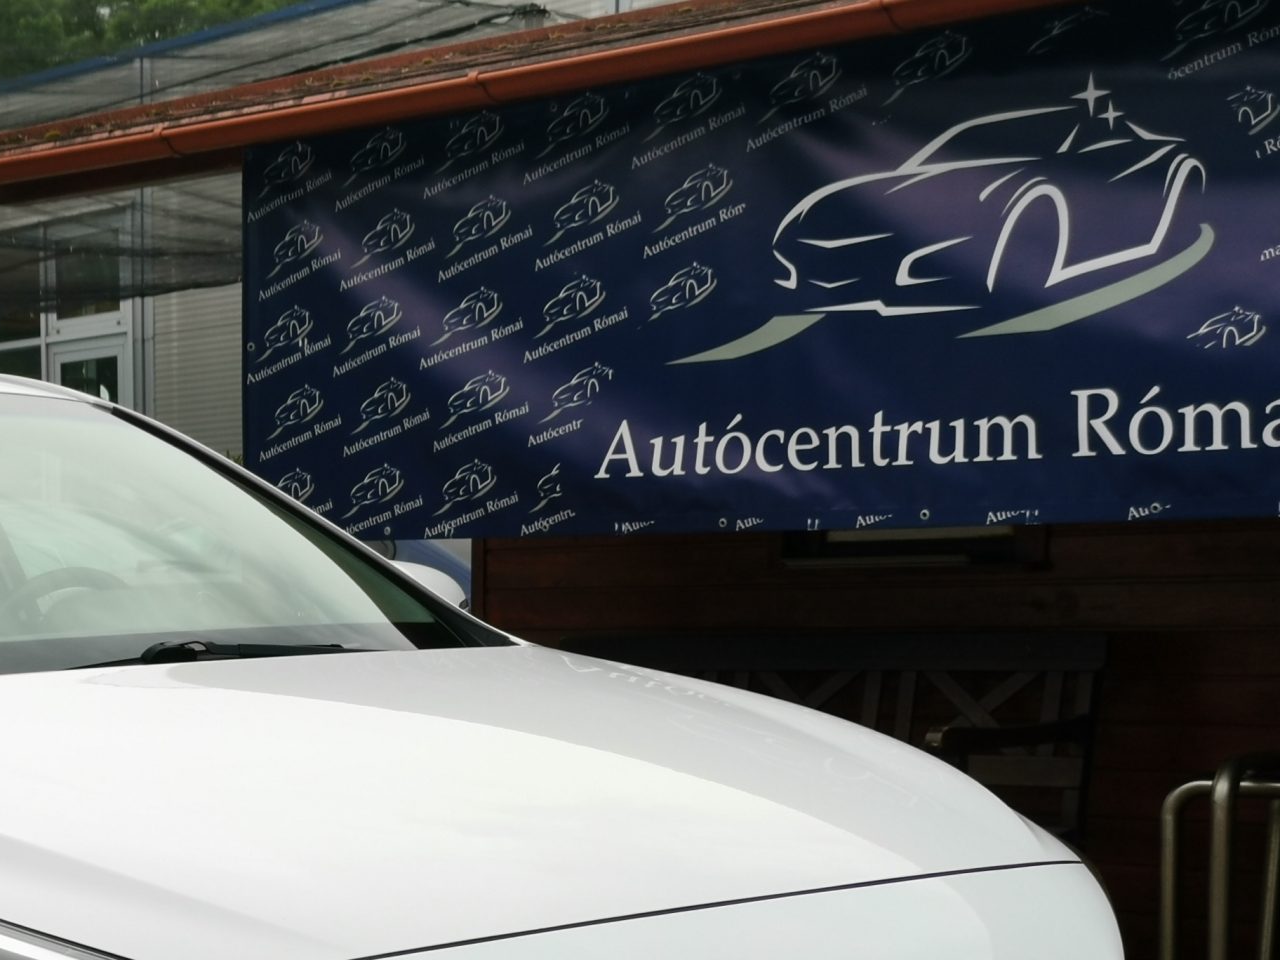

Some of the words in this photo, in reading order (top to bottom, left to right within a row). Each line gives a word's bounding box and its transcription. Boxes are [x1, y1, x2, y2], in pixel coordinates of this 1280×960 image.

[631, 126, 706, 170] Autócentrum
[708, 103, 746, 132] Római
[746, 108, 826, 153] Autócentrum
[828, 84, 868, 113] Római
[423, 161, 489, 200] Autócentrum
[491, 140, 526, 165] Római
[522, 145, 593, 185] Autócentrum
[594, 122, 631, 148] Római
[247, 188, 305, 224] Autócentrum
[305, 169, 334, 193] Római
[335, 174, 392, 213] Autócentrum
[393, 157, 426, 181] Római
[339, 254, 405, 292] Autócentrum
[406, 237, 437, 261] Római
[437, 243, 499, 284] Autócentrum
[500, 225, 534, 250] Római
[534, 231, 605, 272] Autócentrum
[606, 211, 643, 236] Római
[642, 216, 717, 259] Autócentrum
[258, 267, 311, 302] Autócentrum
[310, 248, 342, 273] Római
[246, 350, 303, 385] Autócentrum
[303, 334, 333, 357] Római
[332, 343, 388, 378] Autócentrum
[388, 325, 422, 350] Római
[419, 335, 488, 371] Autócentrum
[490, 316, 524, 342] Római
[523, 325, 592, 364] Autócentrum
[593, 306, 629, 332] Római
[258, 428, 314, 463] Autócentrum
[313, 413, 343, 436] Római
[342, 422, 403, 458] Autócentrum
[403, 407, 431, 431] Római
[432, 418, 493, 453] Autócentrum
[494, 401, 530, 425] Római
[594, 410, 1043, 480] Autócentrum
[342, 510, 393, 536] tócentrum
[393, 495, 424, 516] Római
[423, 506, 486, 539] Autócentrum
[486, 490, 519, 514] Római
